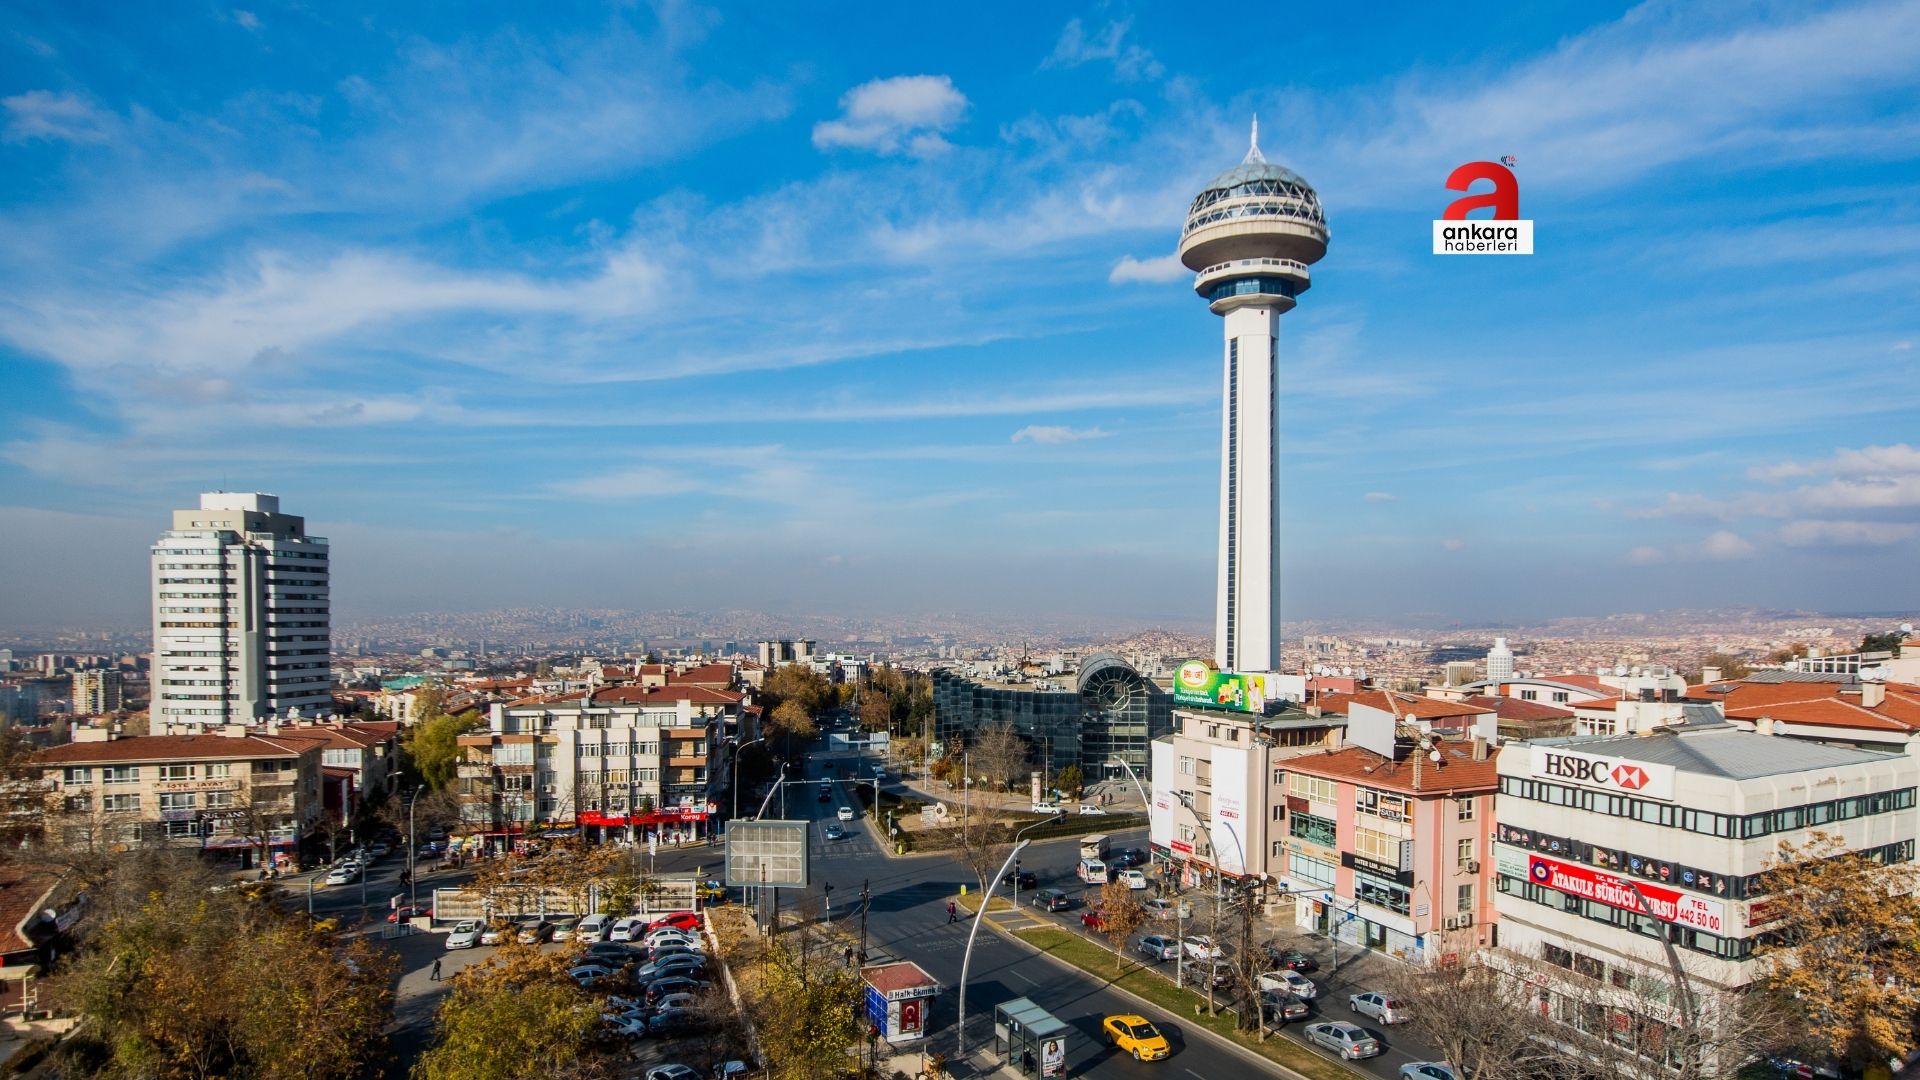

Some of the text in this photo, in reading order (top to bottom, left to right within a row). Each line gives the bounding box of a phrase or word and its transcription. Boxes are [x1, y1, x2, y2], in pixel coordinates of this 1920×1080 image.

[1545, 753, 1609, 783] HSBC
[1551, 871, 1594, 898] ATAKULE
[1595, 881, 1637, 909] SÜRÜCÜ
[1691, 899, 1708, 911] TEL
[1680, 908, 1720, 931] 442 50 00
[894, 990, 911, 999] Halk
